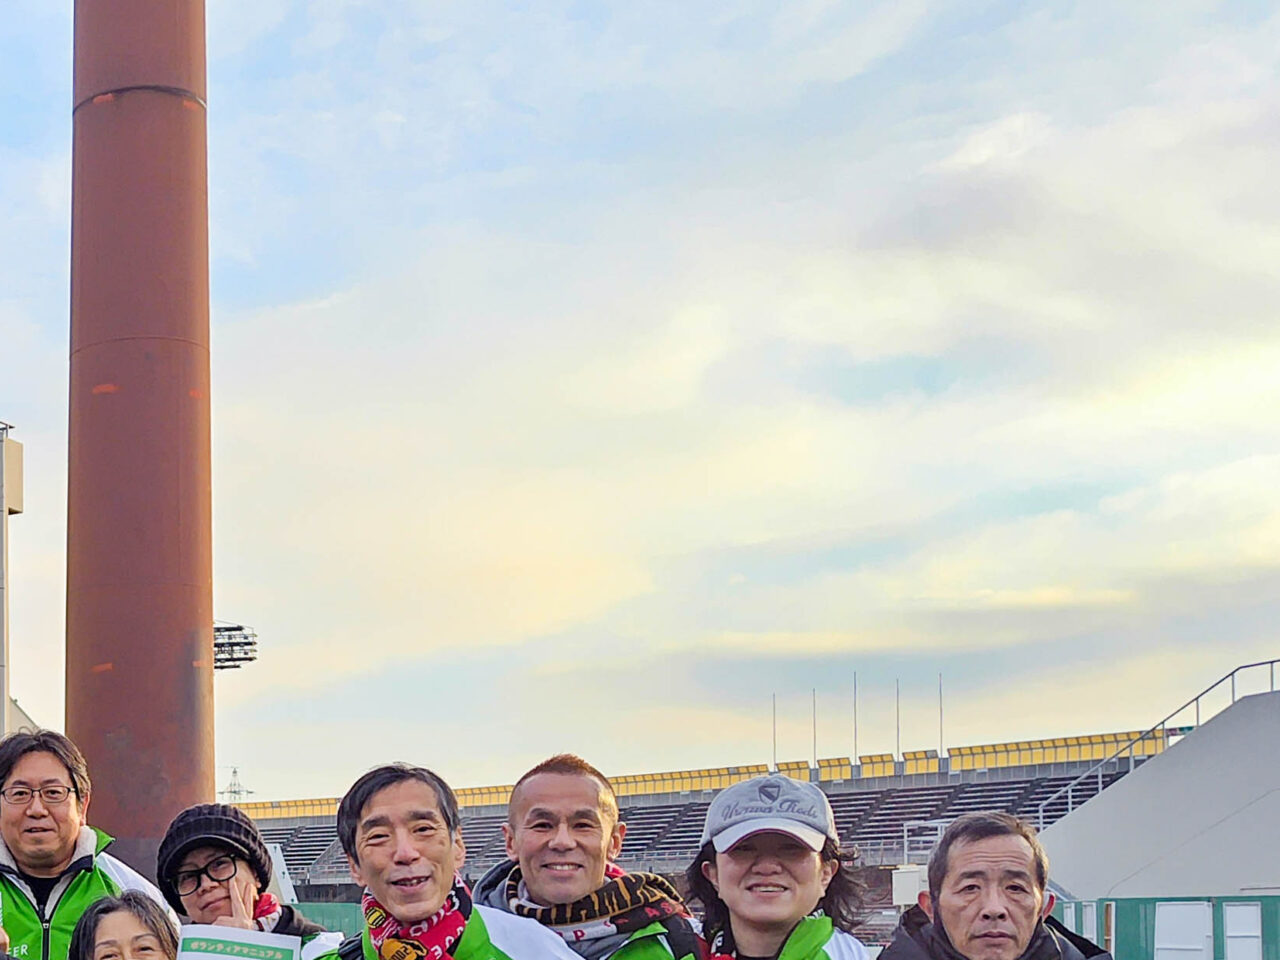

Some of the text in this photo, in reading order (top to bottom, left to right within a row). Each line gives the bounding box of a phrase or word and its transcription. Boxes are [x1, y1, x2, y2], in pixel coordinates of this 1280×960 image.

[190, 942, 284, 960] ボランティアマニュアル
